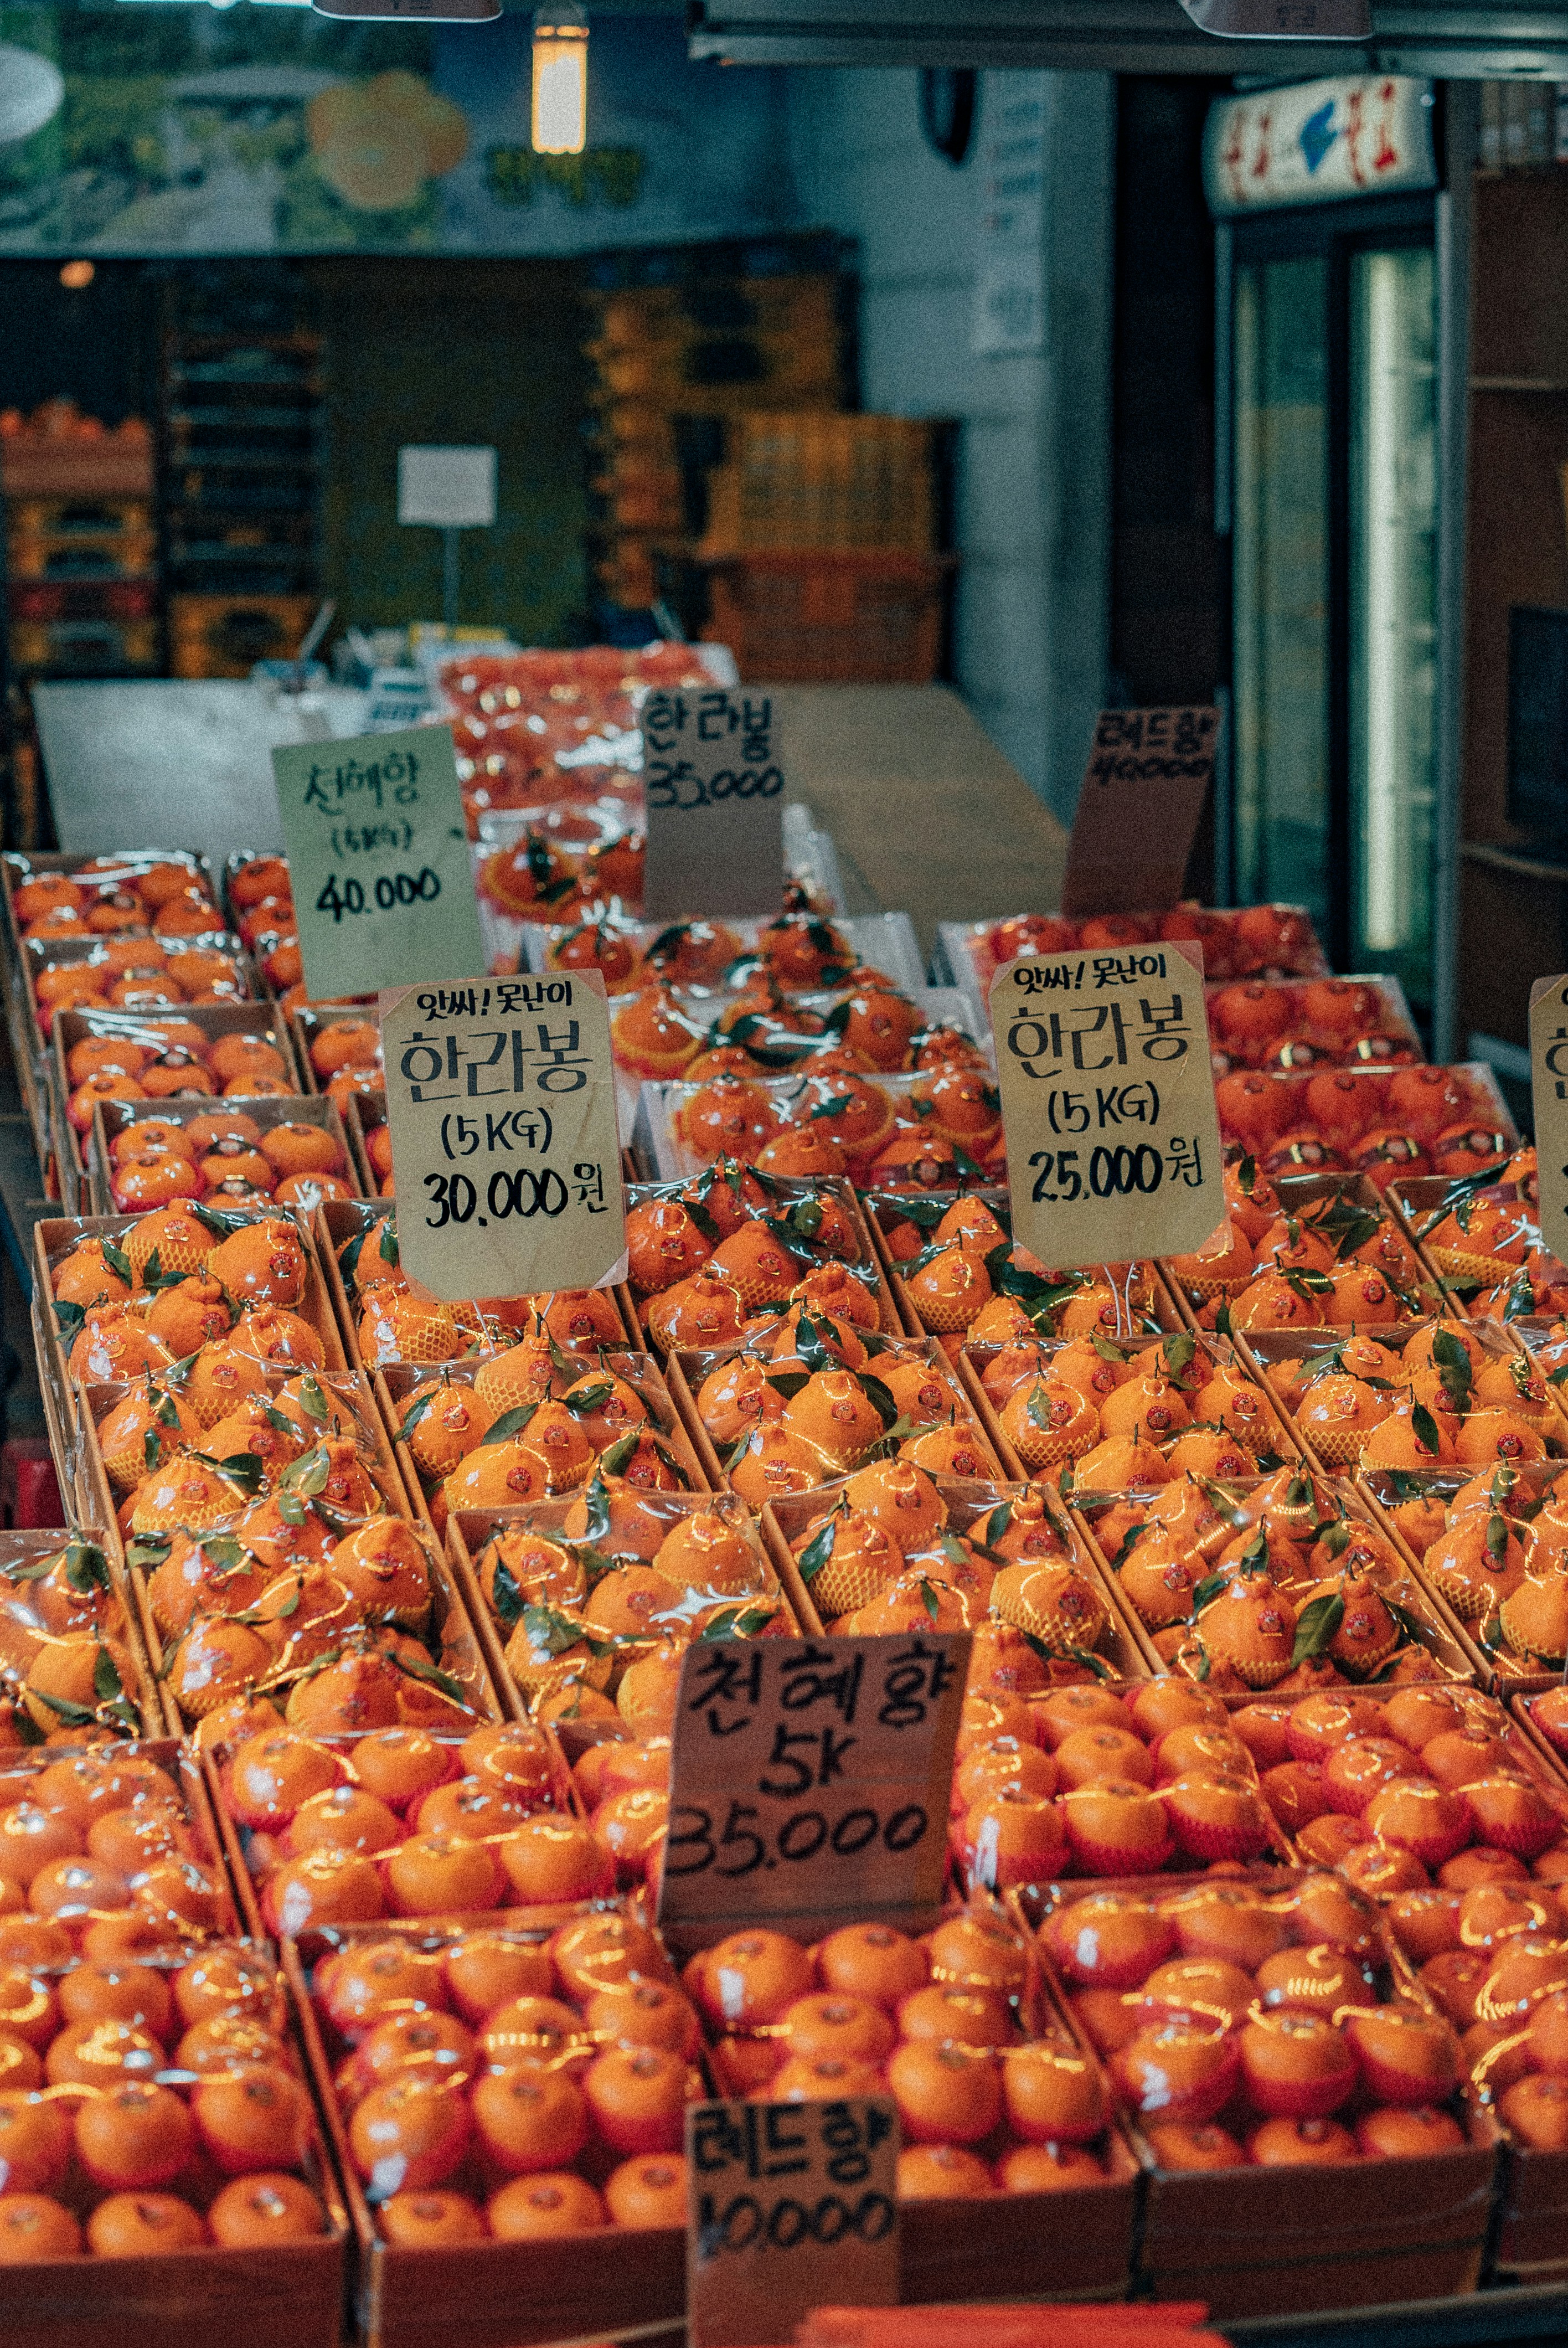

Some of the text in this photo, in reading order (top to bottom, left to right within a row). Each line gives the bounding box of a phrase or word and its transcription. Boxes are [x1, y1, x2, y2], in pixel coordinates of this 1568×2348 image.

[646, 693, 772, 763] 한라봉
[316, 867, 441, 922] 40.000
[416, 980, 572, 1021] 앗싸! 못난이
[1014, 954, 1167, 995] 앗싸! 못난이
[399, 1019, 594, 1103] 한라봉
[1007, 995, 1192, 1079] 한라봉
[441, 1107, 553, 1160] (5KG)
[1048, 1082, 1159, 1134] (5KG)
[689, 1640, 957, 1737] 천혜향
[759, 1723, 857, 1798] 5K
[695, 2103, 892, 2184] 레드향
